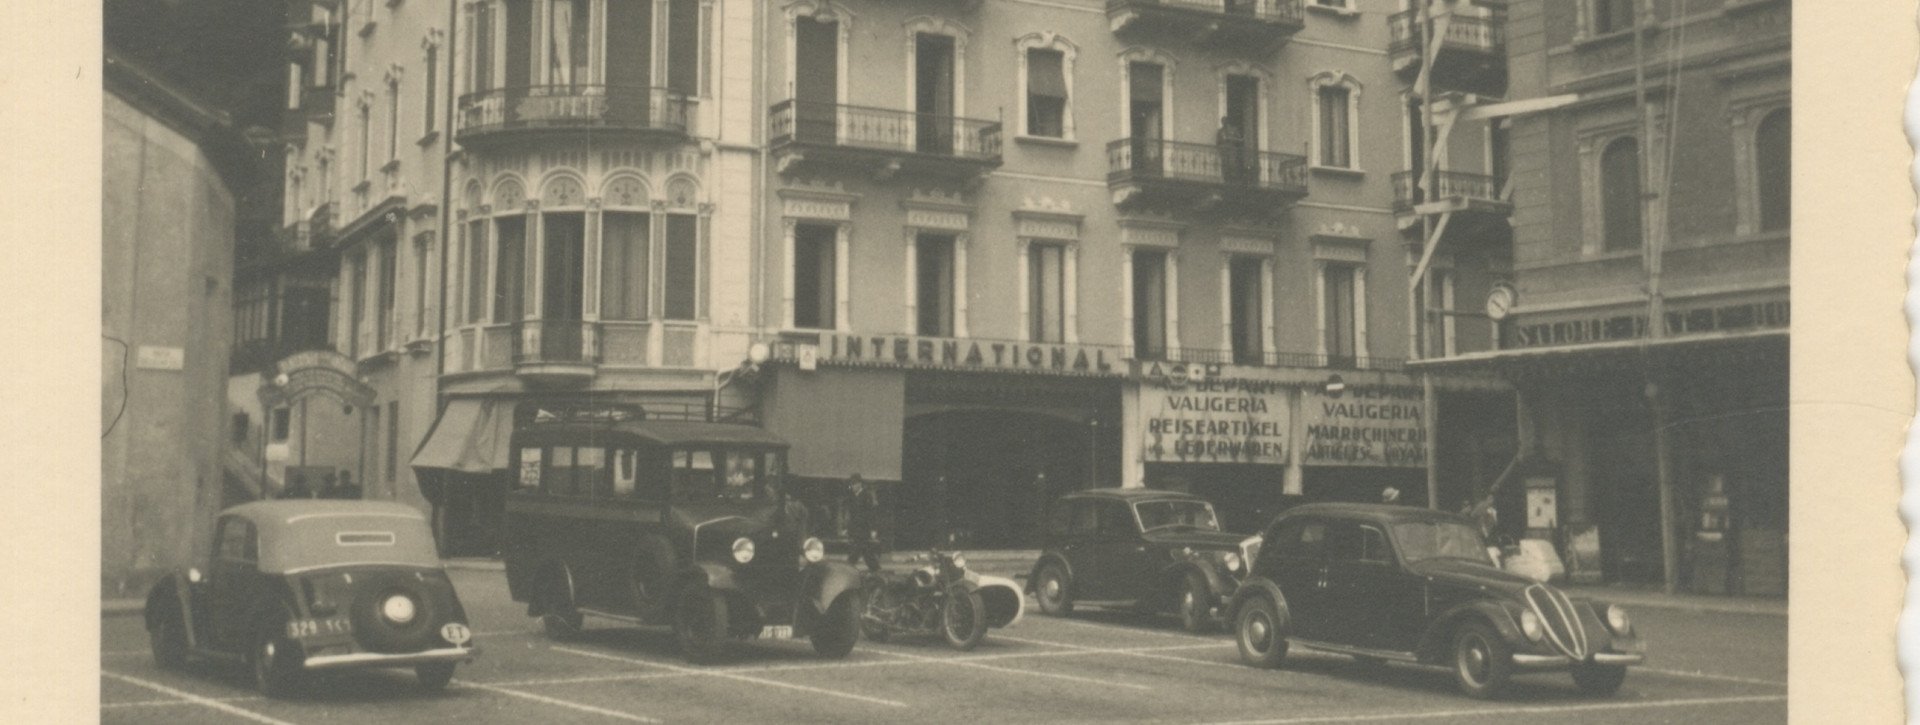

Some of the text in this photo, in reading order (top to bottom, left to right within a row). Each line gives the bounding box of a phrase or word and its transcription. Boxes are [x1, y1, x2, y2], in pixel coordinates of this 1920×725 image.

[830, 334, 1112, 371] INTERNATIONAL
[1168, 396, 1268, 413] VALIGERIA
[1322, 402, 1421, 420] VALIGERIA
[1149, 418, 1282, 437] REISEARTIKEL
